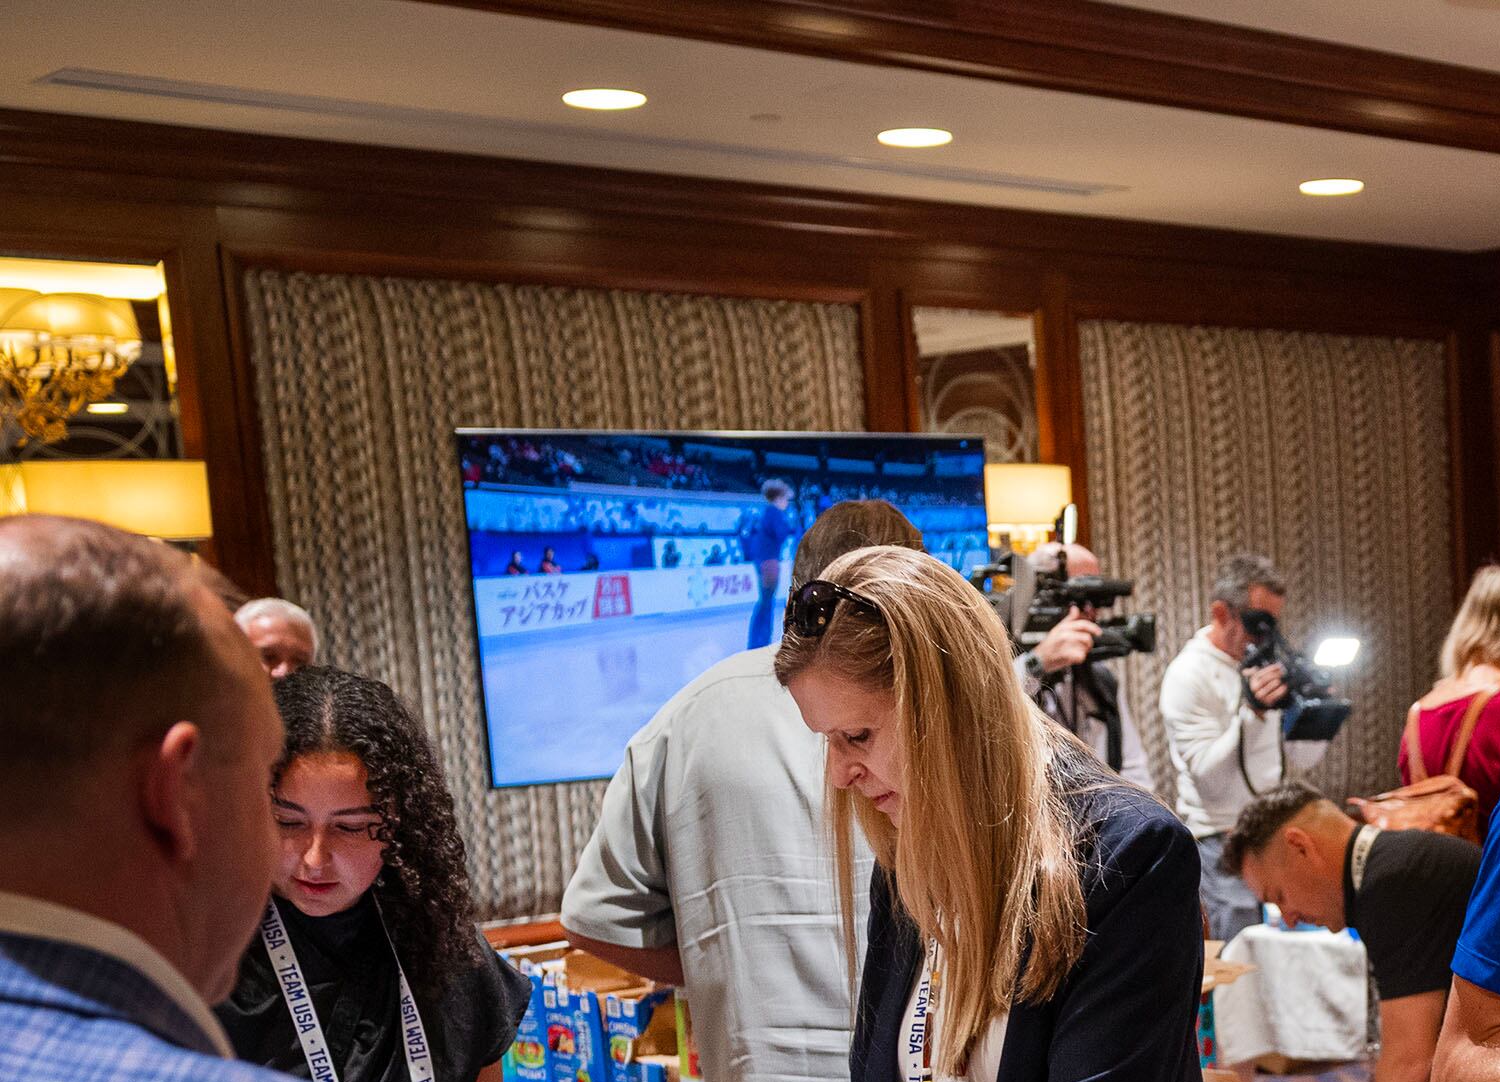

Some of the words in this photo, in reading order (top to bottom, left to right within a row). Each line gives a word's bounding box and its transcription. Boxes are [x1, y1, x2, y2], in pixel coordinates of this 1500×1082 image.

[279, 963, 305, 1000] TEAM
[294, 1003, 315, 1034] USA
[401, 995, 417, 1025] USA
[914, 980, 929, 1017] TEAM
[408, 1023, 427, 1062] TEAM
[909, 1022, 924, 1054] USA
